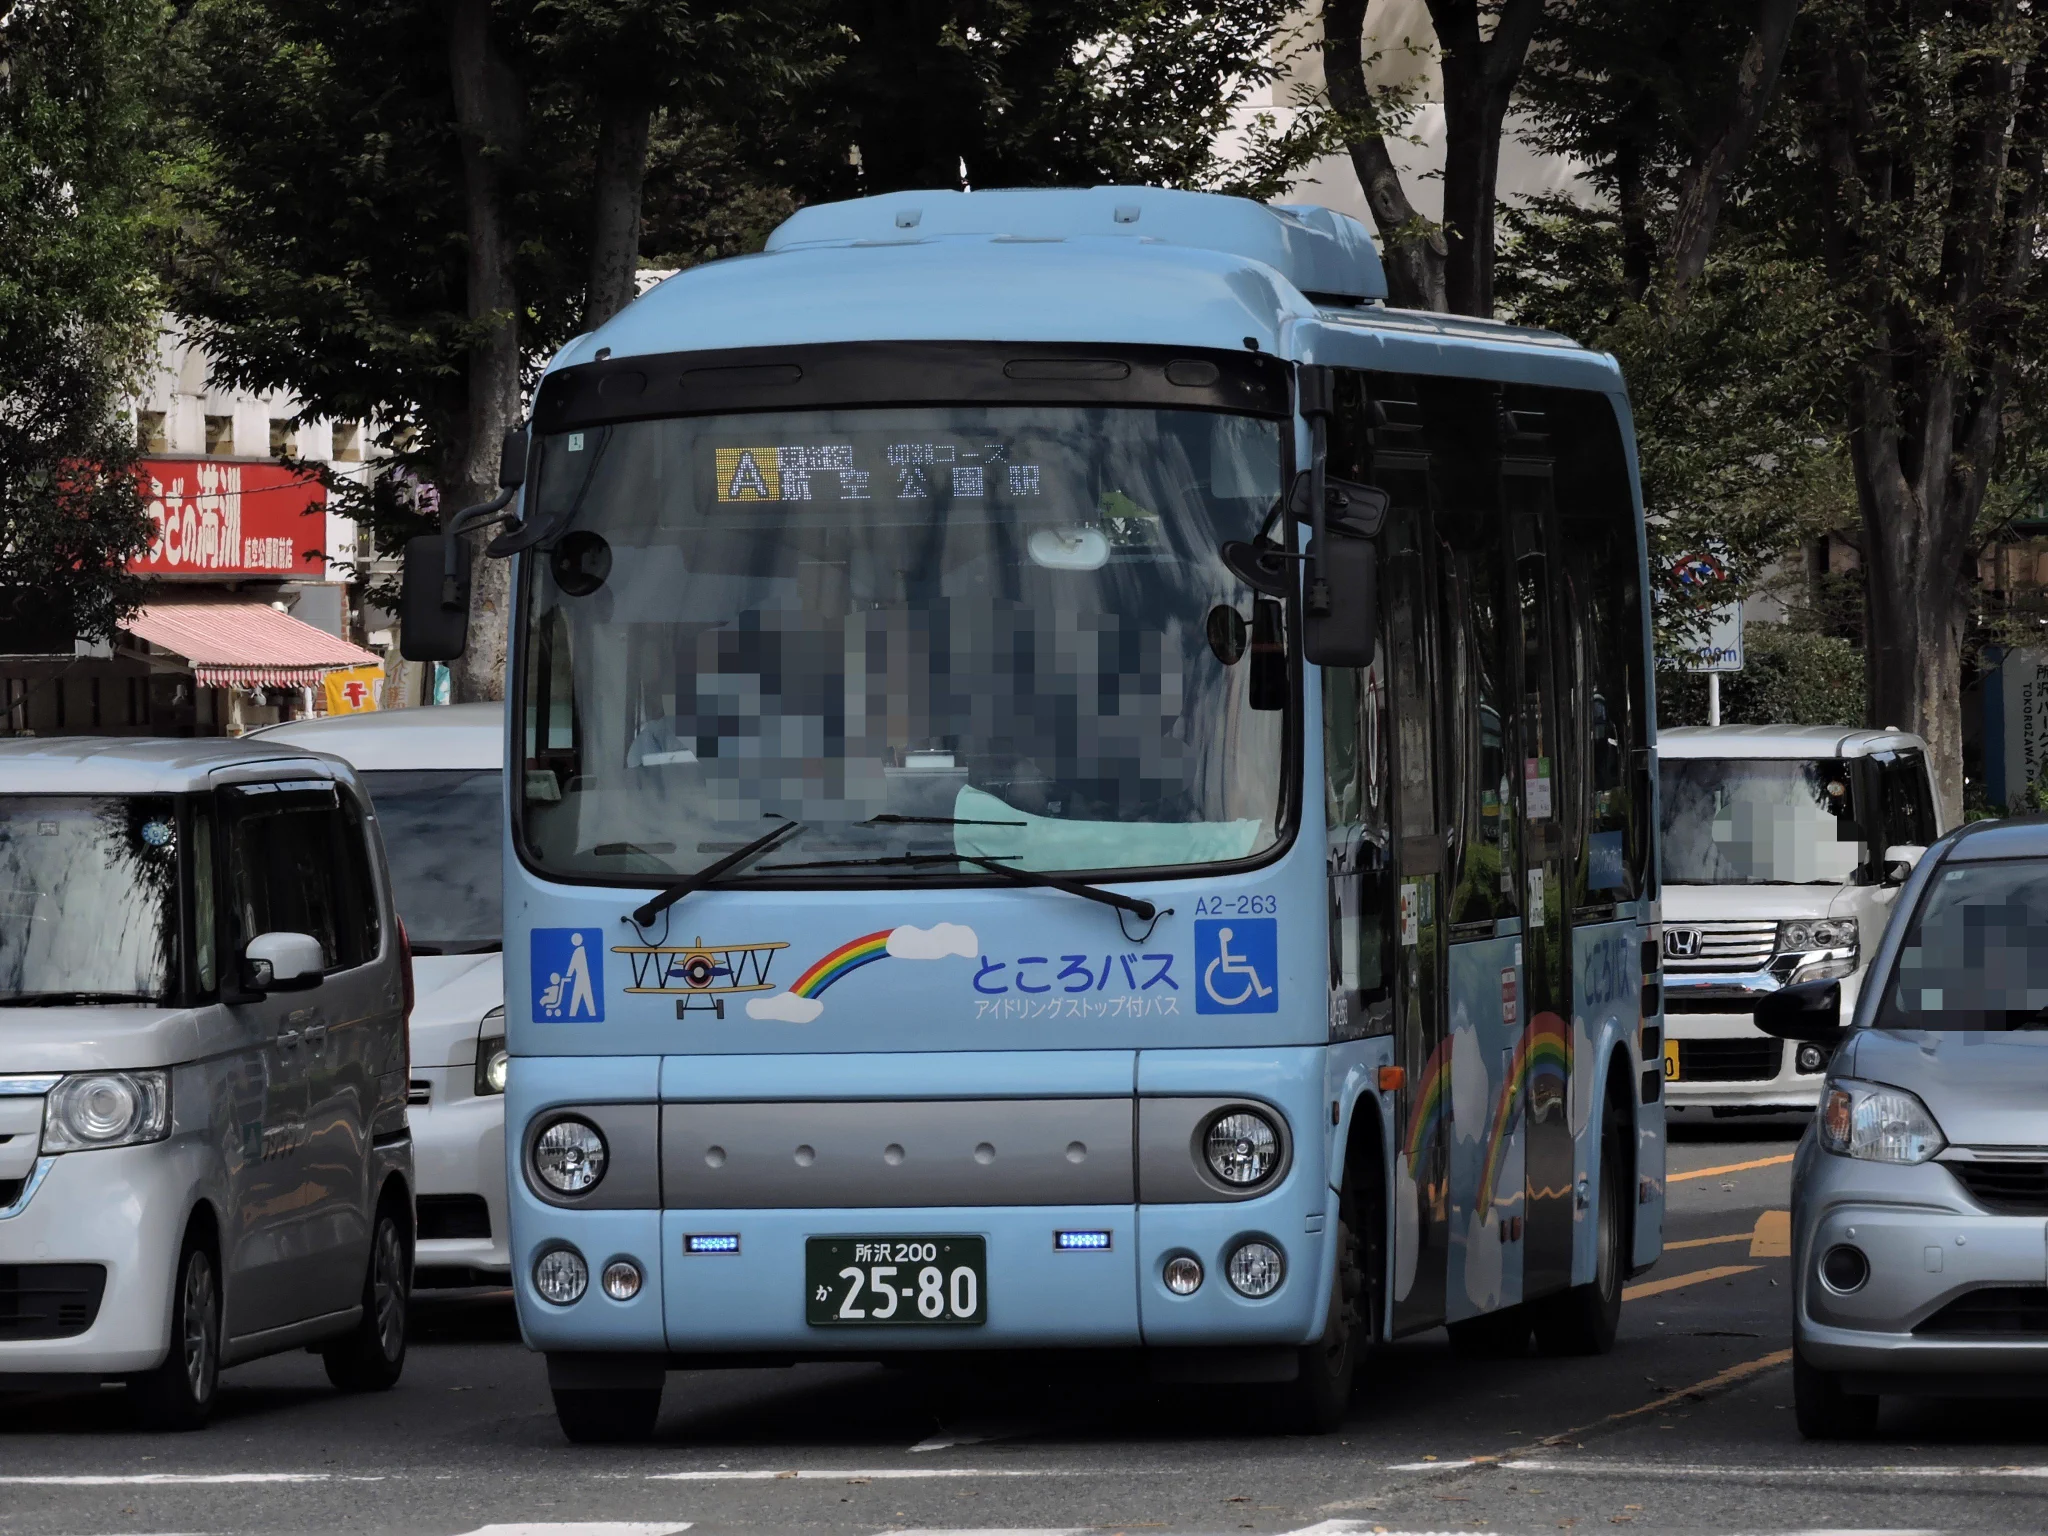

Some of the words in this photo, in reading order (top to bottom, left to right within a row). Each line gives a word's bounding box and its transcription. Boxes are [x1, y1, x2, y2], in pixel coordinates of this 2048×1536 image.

[730, 452, 767, 496] A
[2022, 682, 2035, 765] TOKOROZAWA
[1194, 895, 1278, 915] A2-263
[972, 953, 1180, 993] ところバス
[973, 996, 1181, 1021] アイドリングストップ付バス
[815, 1284, 833, 1302] か
[838, 1266, 978, 1320] 25-80
